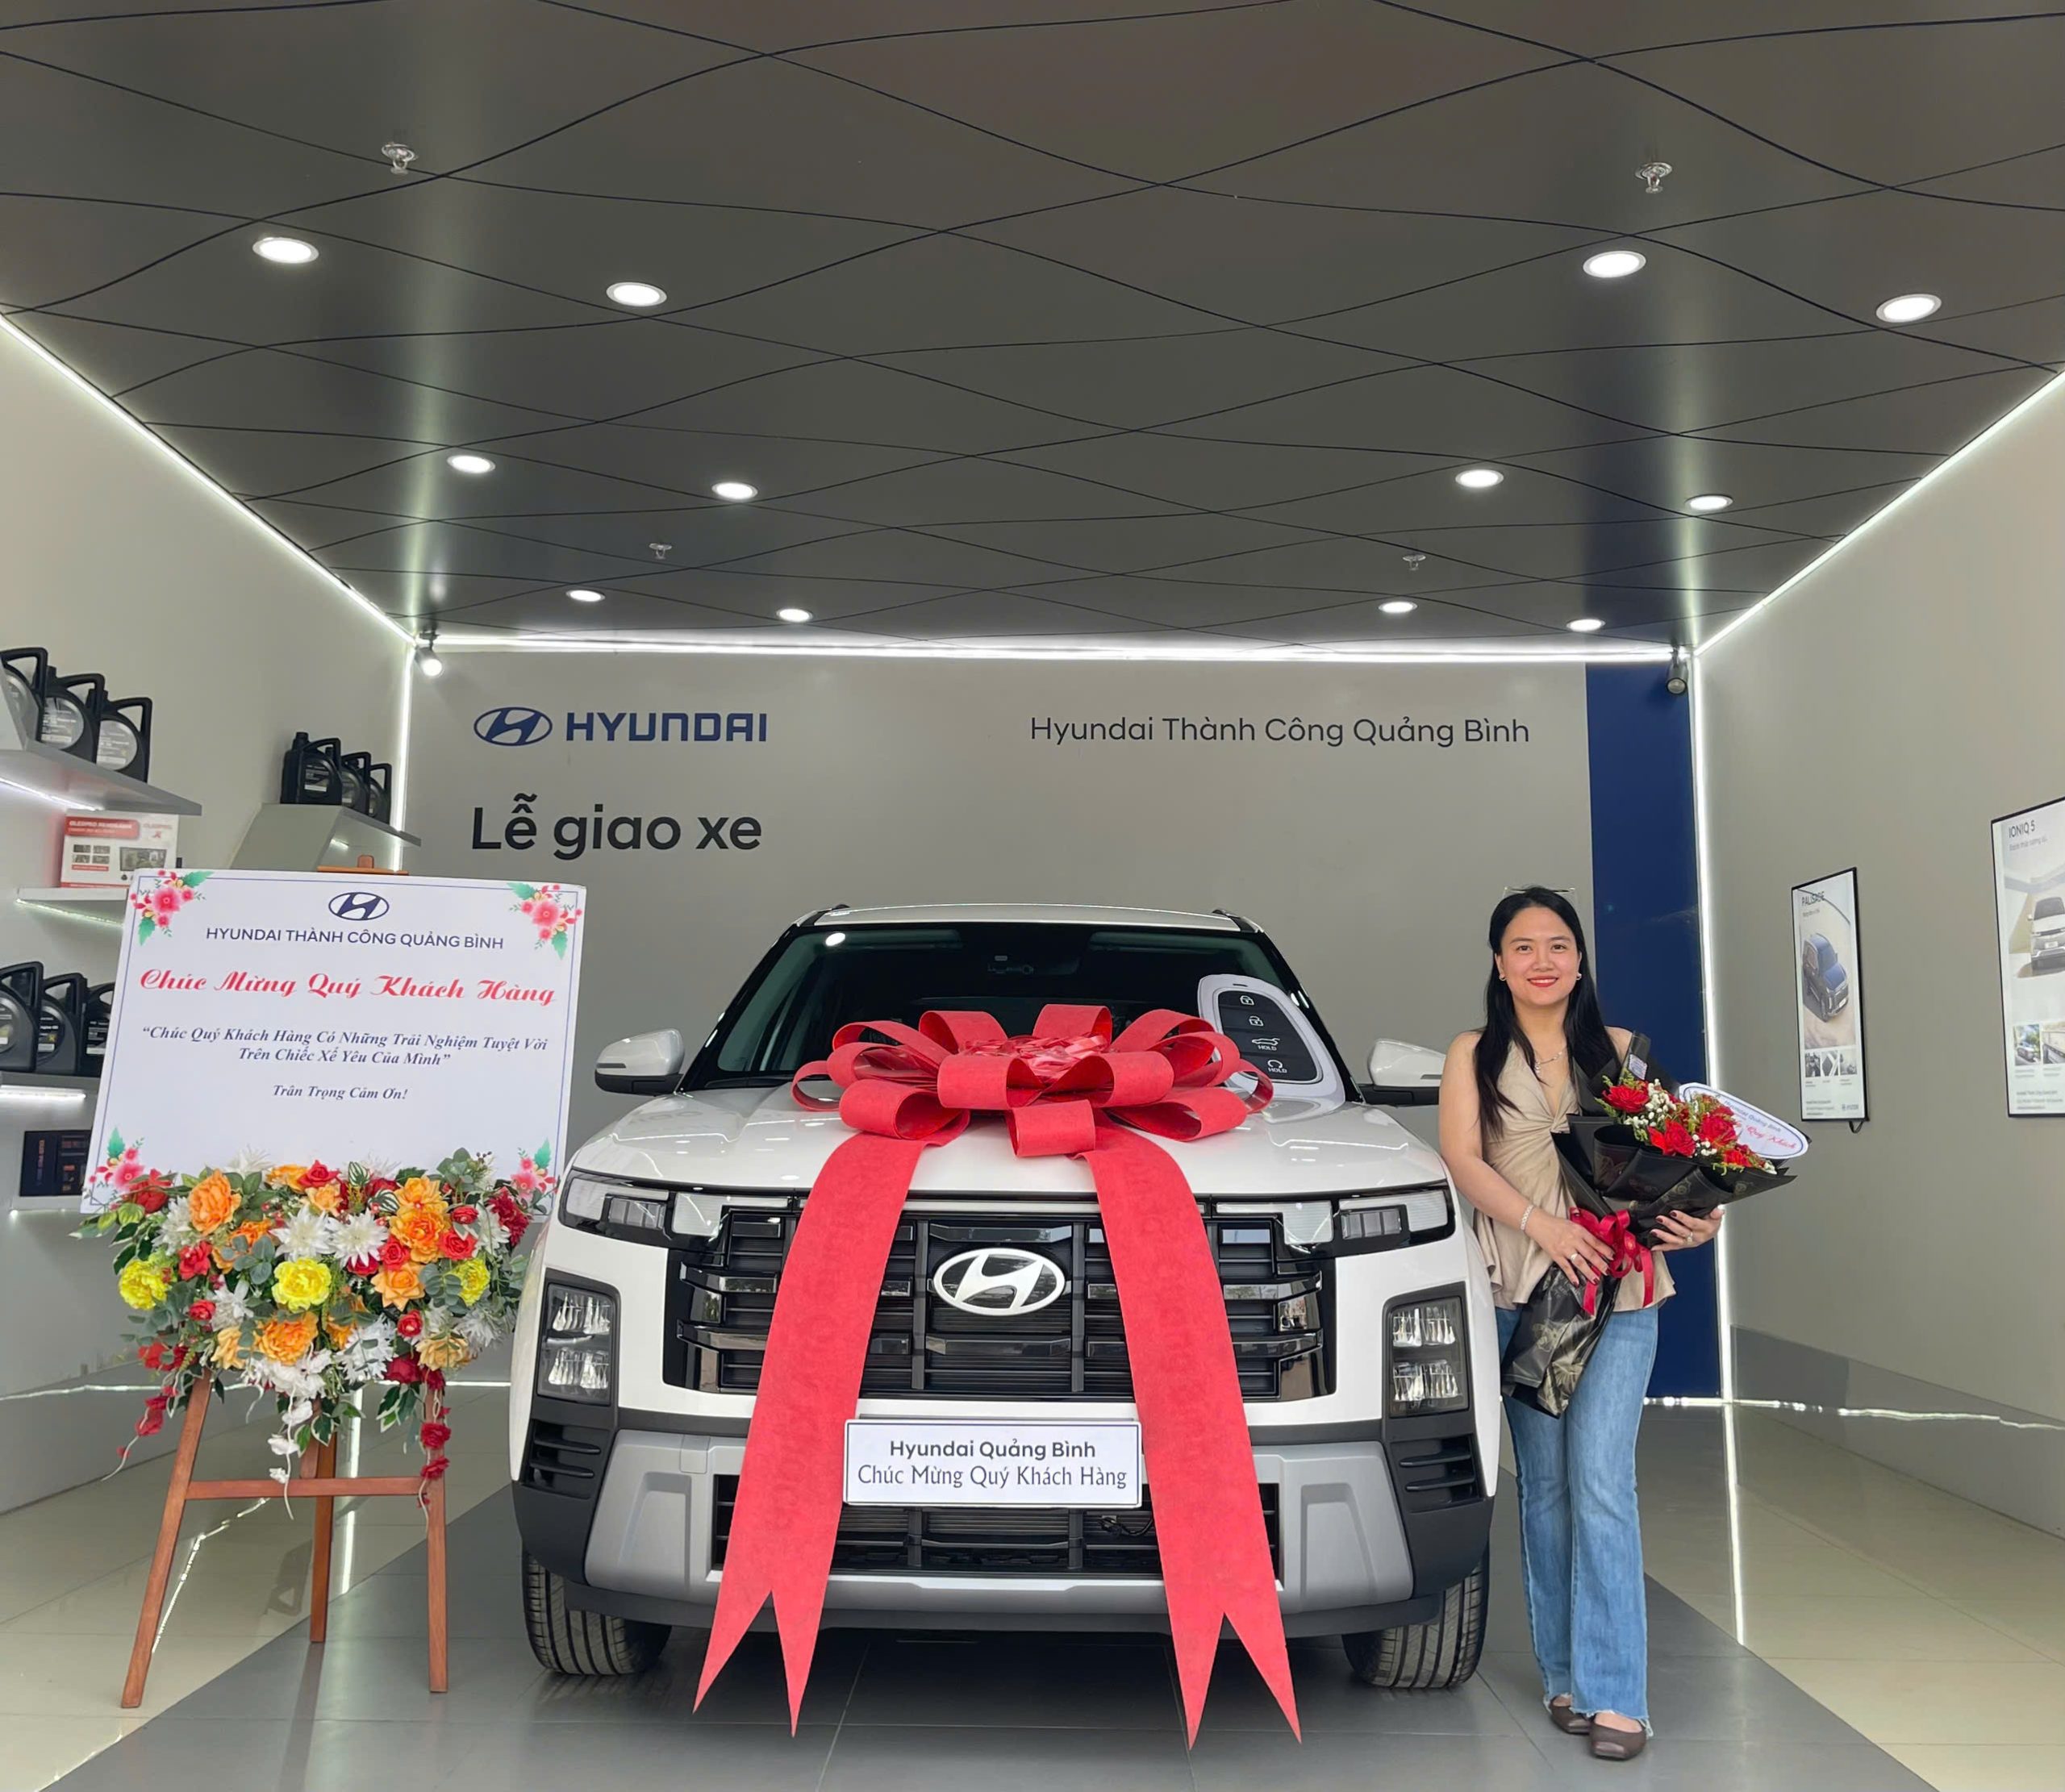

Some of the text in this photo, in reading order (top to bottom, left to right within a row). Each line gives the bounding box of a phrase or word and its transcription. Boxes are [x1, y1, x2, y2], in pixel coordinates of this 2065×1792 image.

[566, 712, 766, 742] HYUNDAI
[1032, 716, 1529, 748] Hyundai Thành Công Quảng Bình
[472, 793, 761, 861] Lễ giao xe
[2009, 819, 2035, 838] IONIQ 5
[206, 927, 503, 949] HYUNDAI THÀNH CÔNG QUẢNG BÌNH
[140, 969, 554, 1006] Chúc Mừng Quý Khách Hàng
[143, 1027, 548, 1051] “Chúc Quý Khách Hàng Có Những Trải Nghiệm Tuyệt Vời
[240, 1048, 269, 1060] Trên
[275, 1046, 315, 1061] Chiếc
[343, 1051, 367, 1062] Yêu
[372, 1052, 399, 1064] Của
[403, 1053, 450, 1065] Mình”
[274, 1086, 407, 1100] Trân Trọng Cảm Ơn!
[891, 1438, 1095, 1461] Hyundai Quảng Bình
[858, 1465, 1127, 1489] Chúc Mừng Quý Khách Hàng
